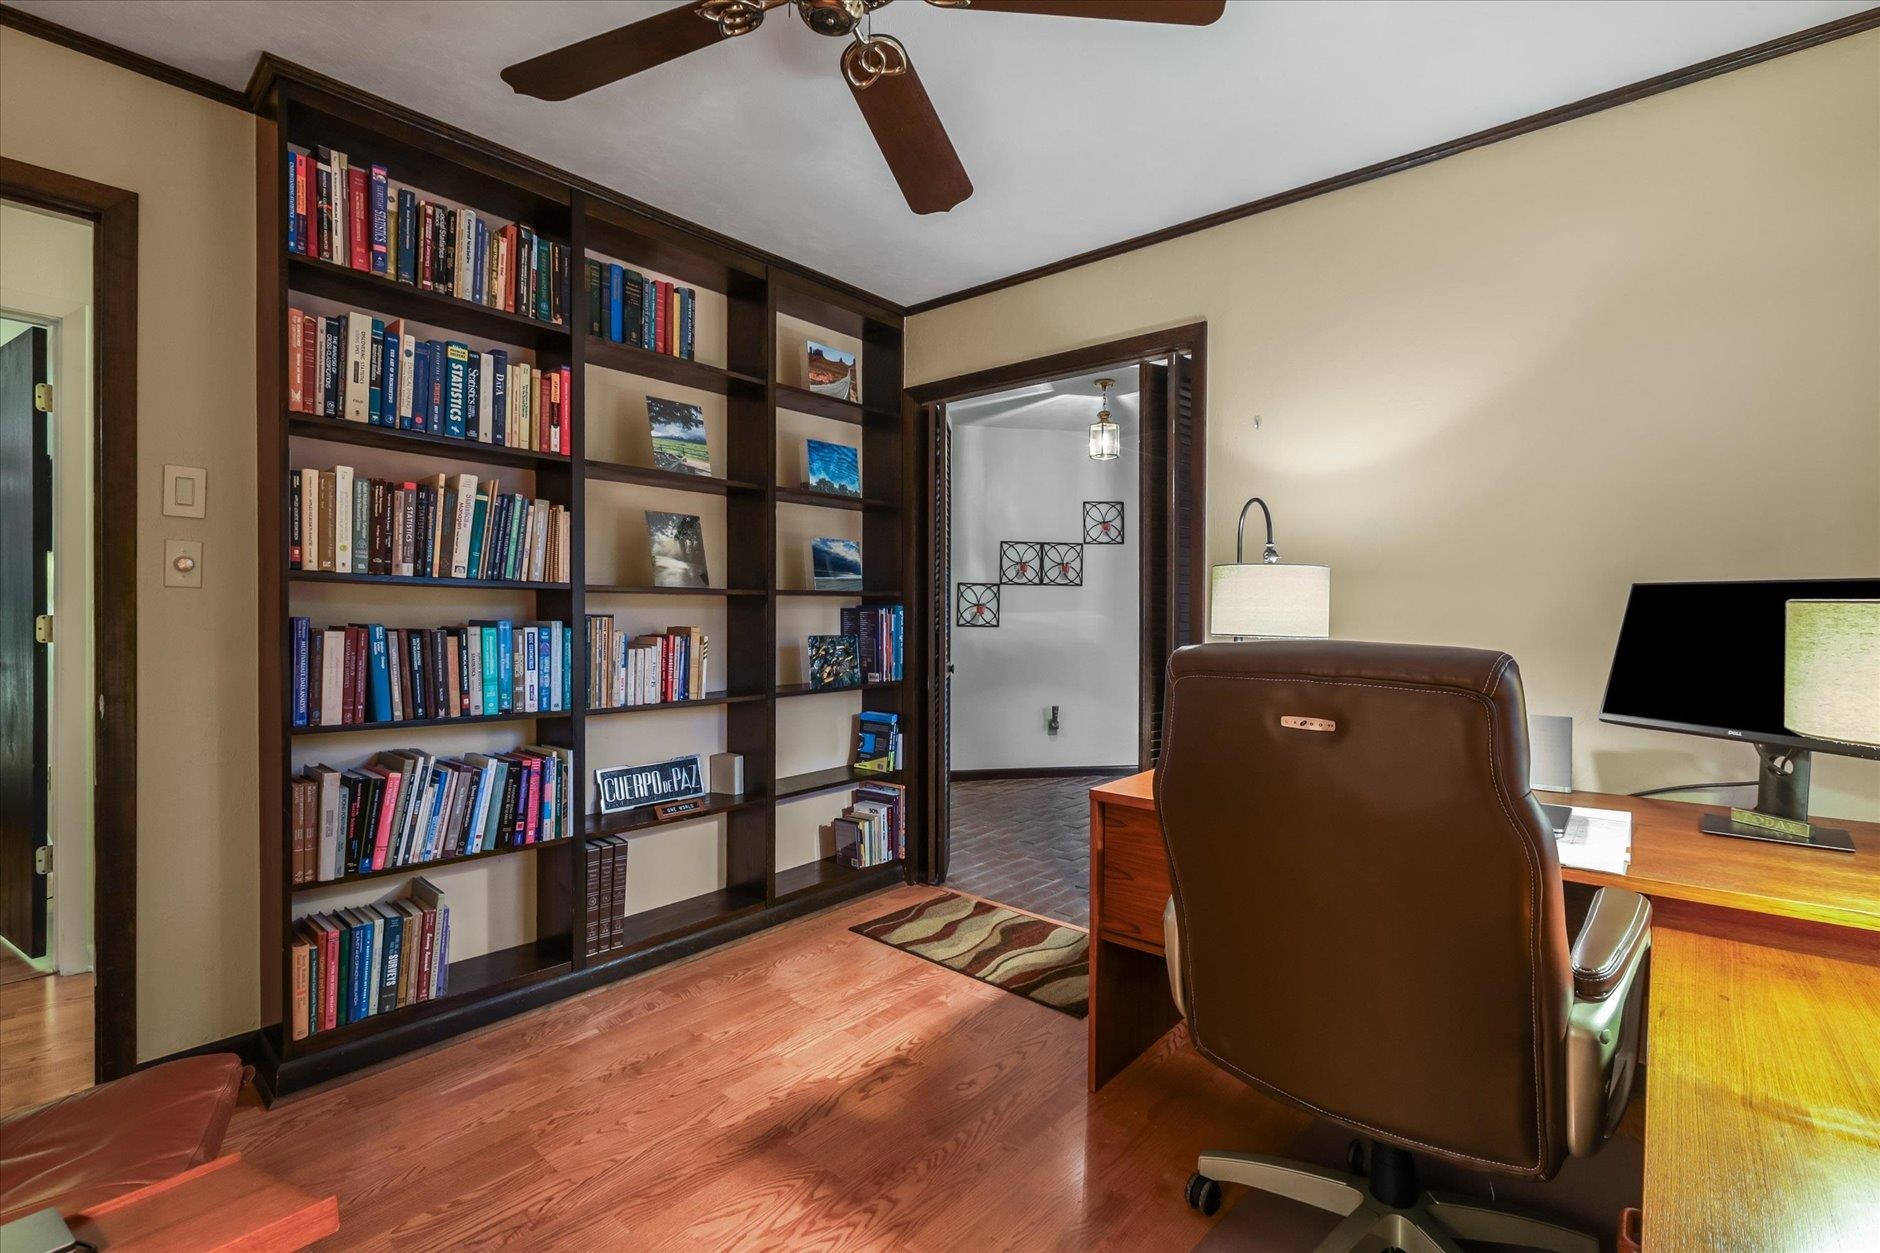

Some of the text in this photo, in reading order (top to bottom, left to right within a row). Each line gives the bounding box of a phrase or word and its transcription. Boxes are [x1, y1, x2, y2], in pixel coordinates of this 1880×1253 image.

[374, 210, 386, 243] STATISTICS
[438, 229, 446, 258] Statistics
[433, 383, 441, 405] STATISTICS
[450, 363, 463, 422] STATISTICS
[467, 368, 479, 405] Statistics
[405, 506, 413, 542] STATISTICS
[417, 505, 425, 540] STATISTICS
[463, 494, 473, 522] Statistics
[604, 764, 701, 803] CUERPO DE PAZ
[666, 803, 695, 814] ONE WORLD
[1744, 813, 1797, 834] TODAY
[424, 933, 433, 950] Survey
[386, 954, 399, 987] SURVEYS
